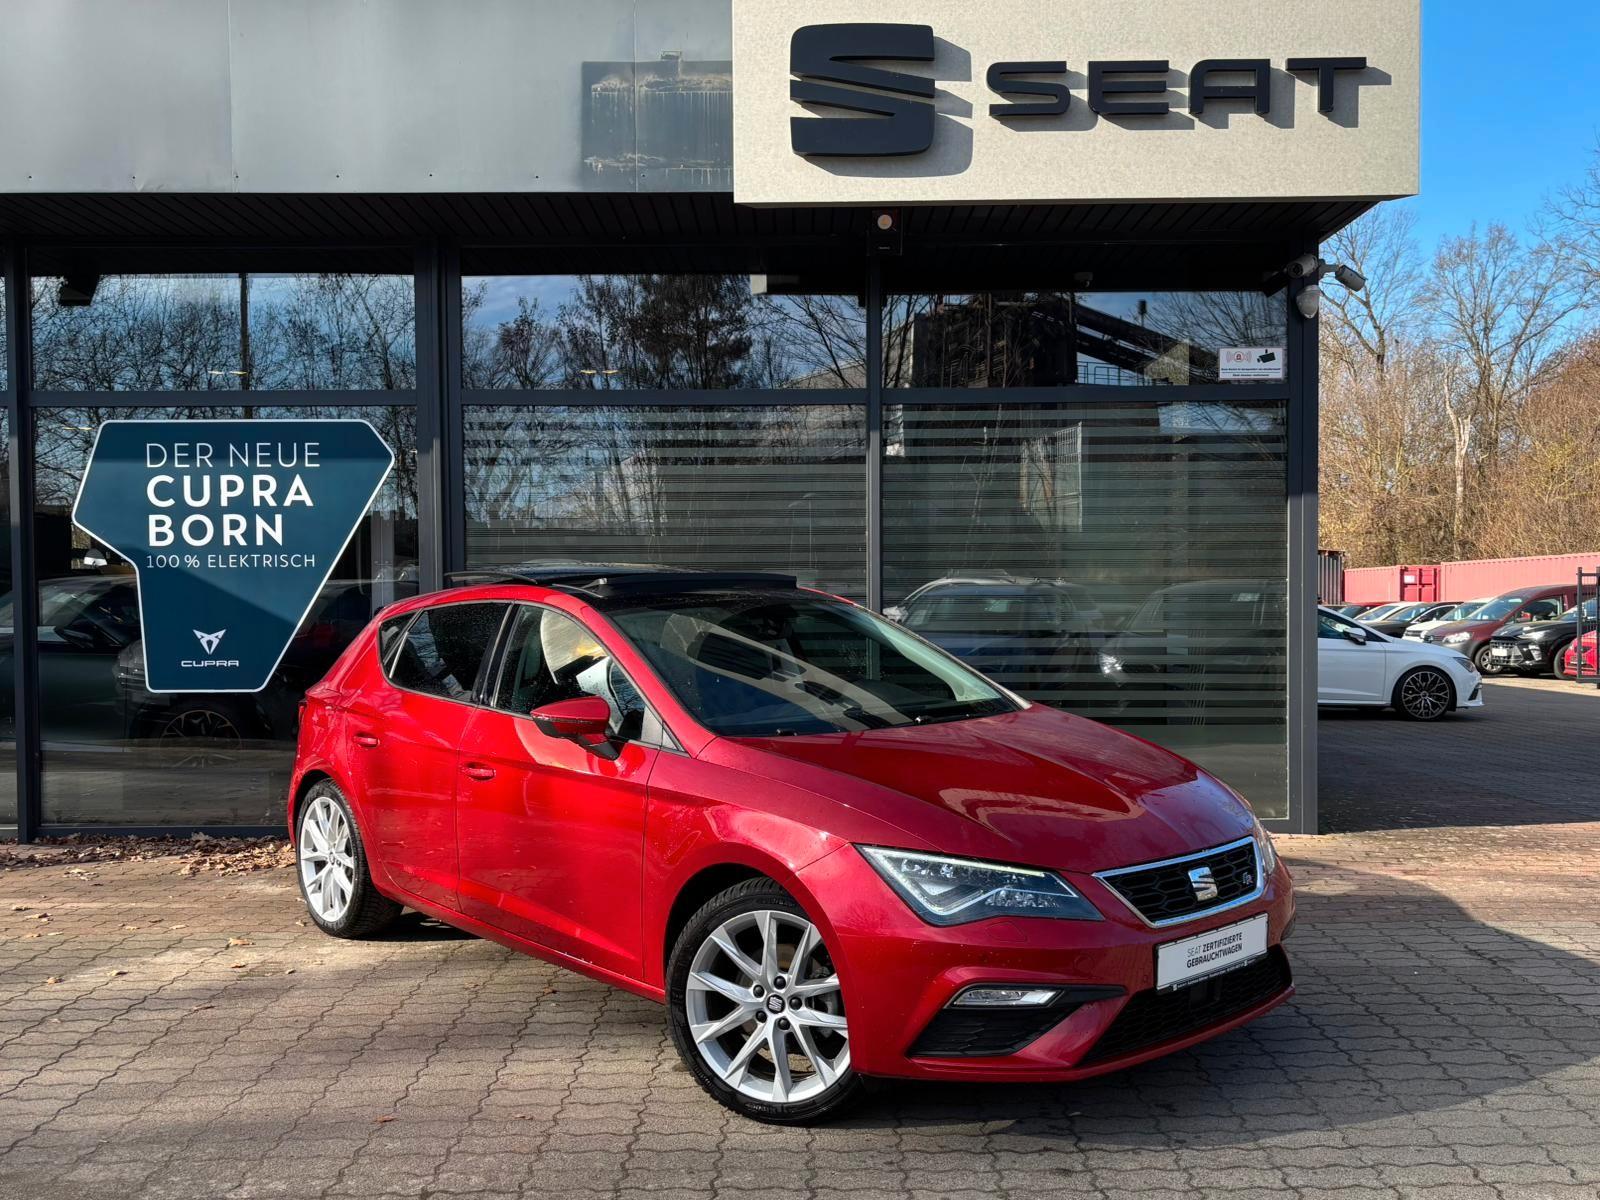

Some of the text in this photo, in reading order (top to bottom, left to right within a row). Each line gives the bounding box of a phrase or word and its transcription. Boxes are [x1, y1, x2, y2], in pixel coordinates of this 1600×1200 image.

[986, 57, 1367, 116] SEAT
[146, 442, 321, 468] DER NEUE
[146, 473, 314, 508] CUPRA
[148, 513, 283, 547] BORN
[146, 554, 316, 569] 100 % ELEKTRISCH
[181, 660, 240, 668] CUPRA
[1186, 943, 1243, 969] GEBRAUCHTWAGEN
[1187, 932, 1243, 958] SEAT ZERTIFIZIERTE
